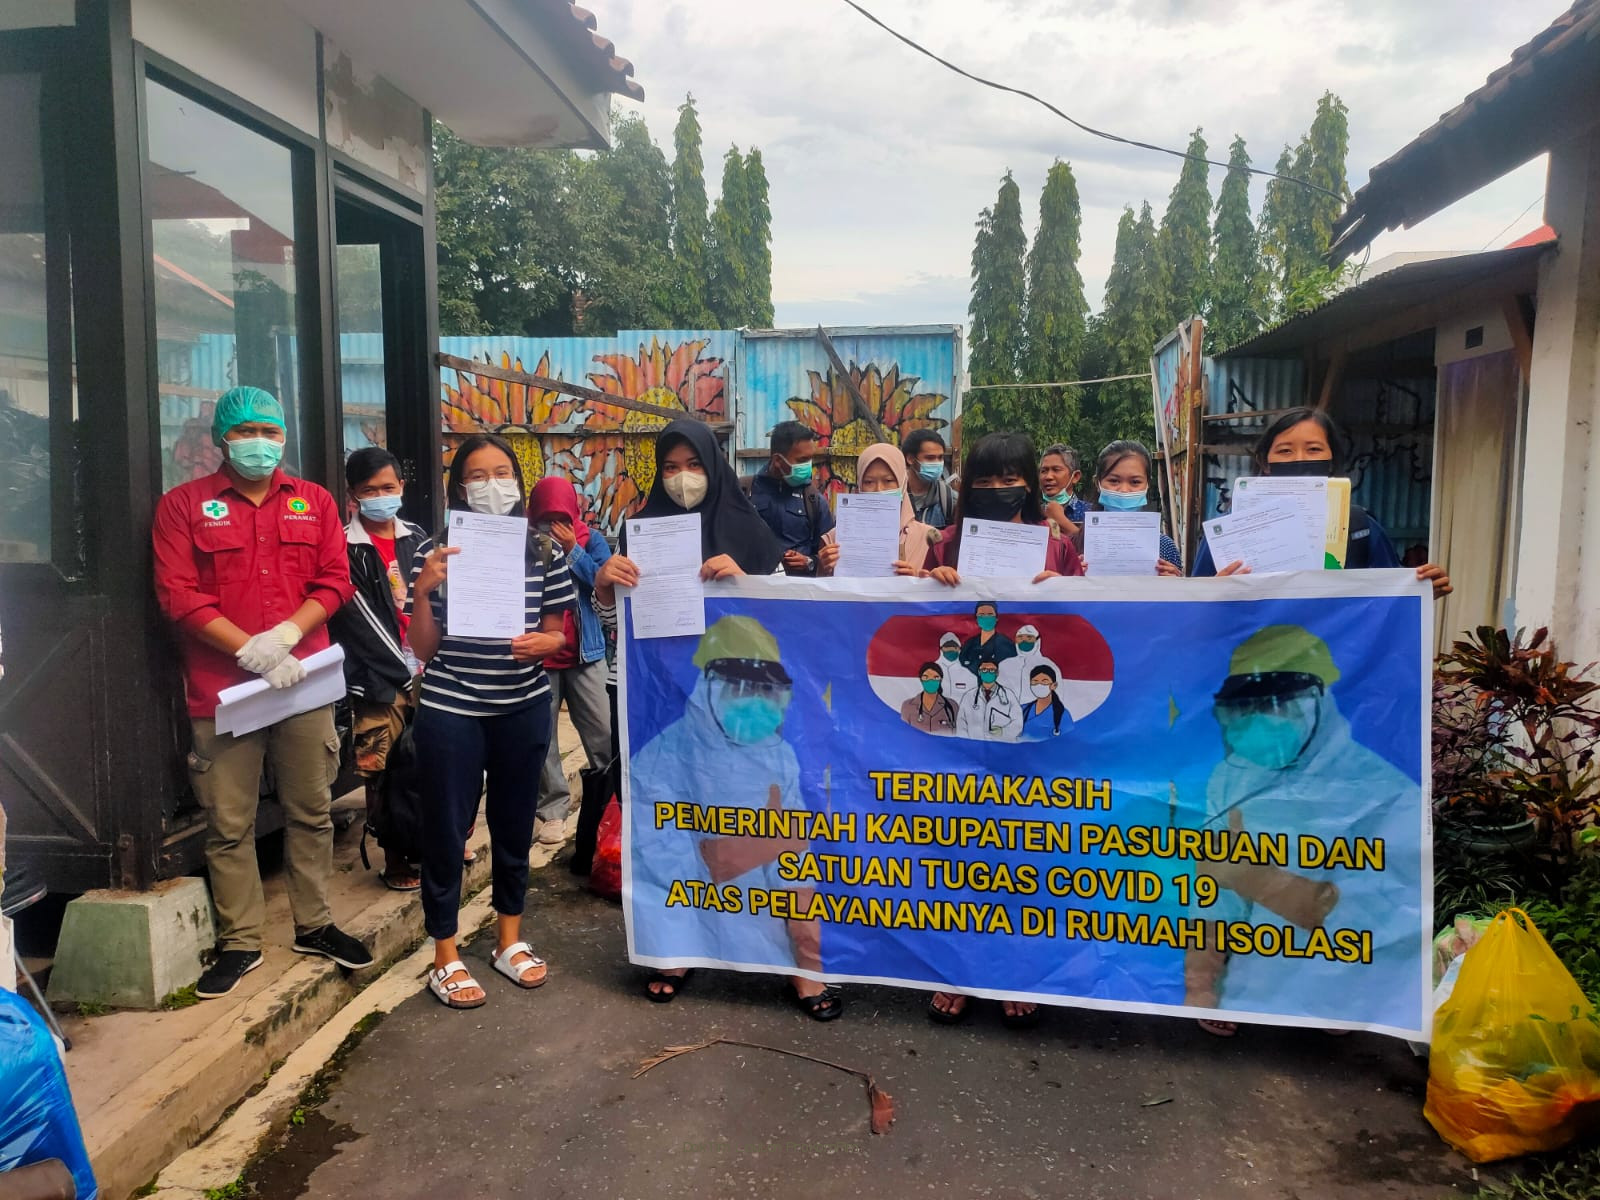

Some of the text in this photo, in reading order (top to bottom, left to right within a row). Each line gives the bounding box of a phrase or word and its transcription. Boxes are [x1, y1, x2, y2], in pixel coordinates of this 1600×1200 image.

[869, 770, 1112, 811] TERIMAKASIH
[654, 801, 1385, 871] PEMERINTAH KABUPATEN PASURUAN DAN
[778, 851, 1219, 908] SATUAN TUGAS COVID 19
[665, 879, 1373, 964] ATAS PELAYANANNYA DI RUMAH ISOLASI
